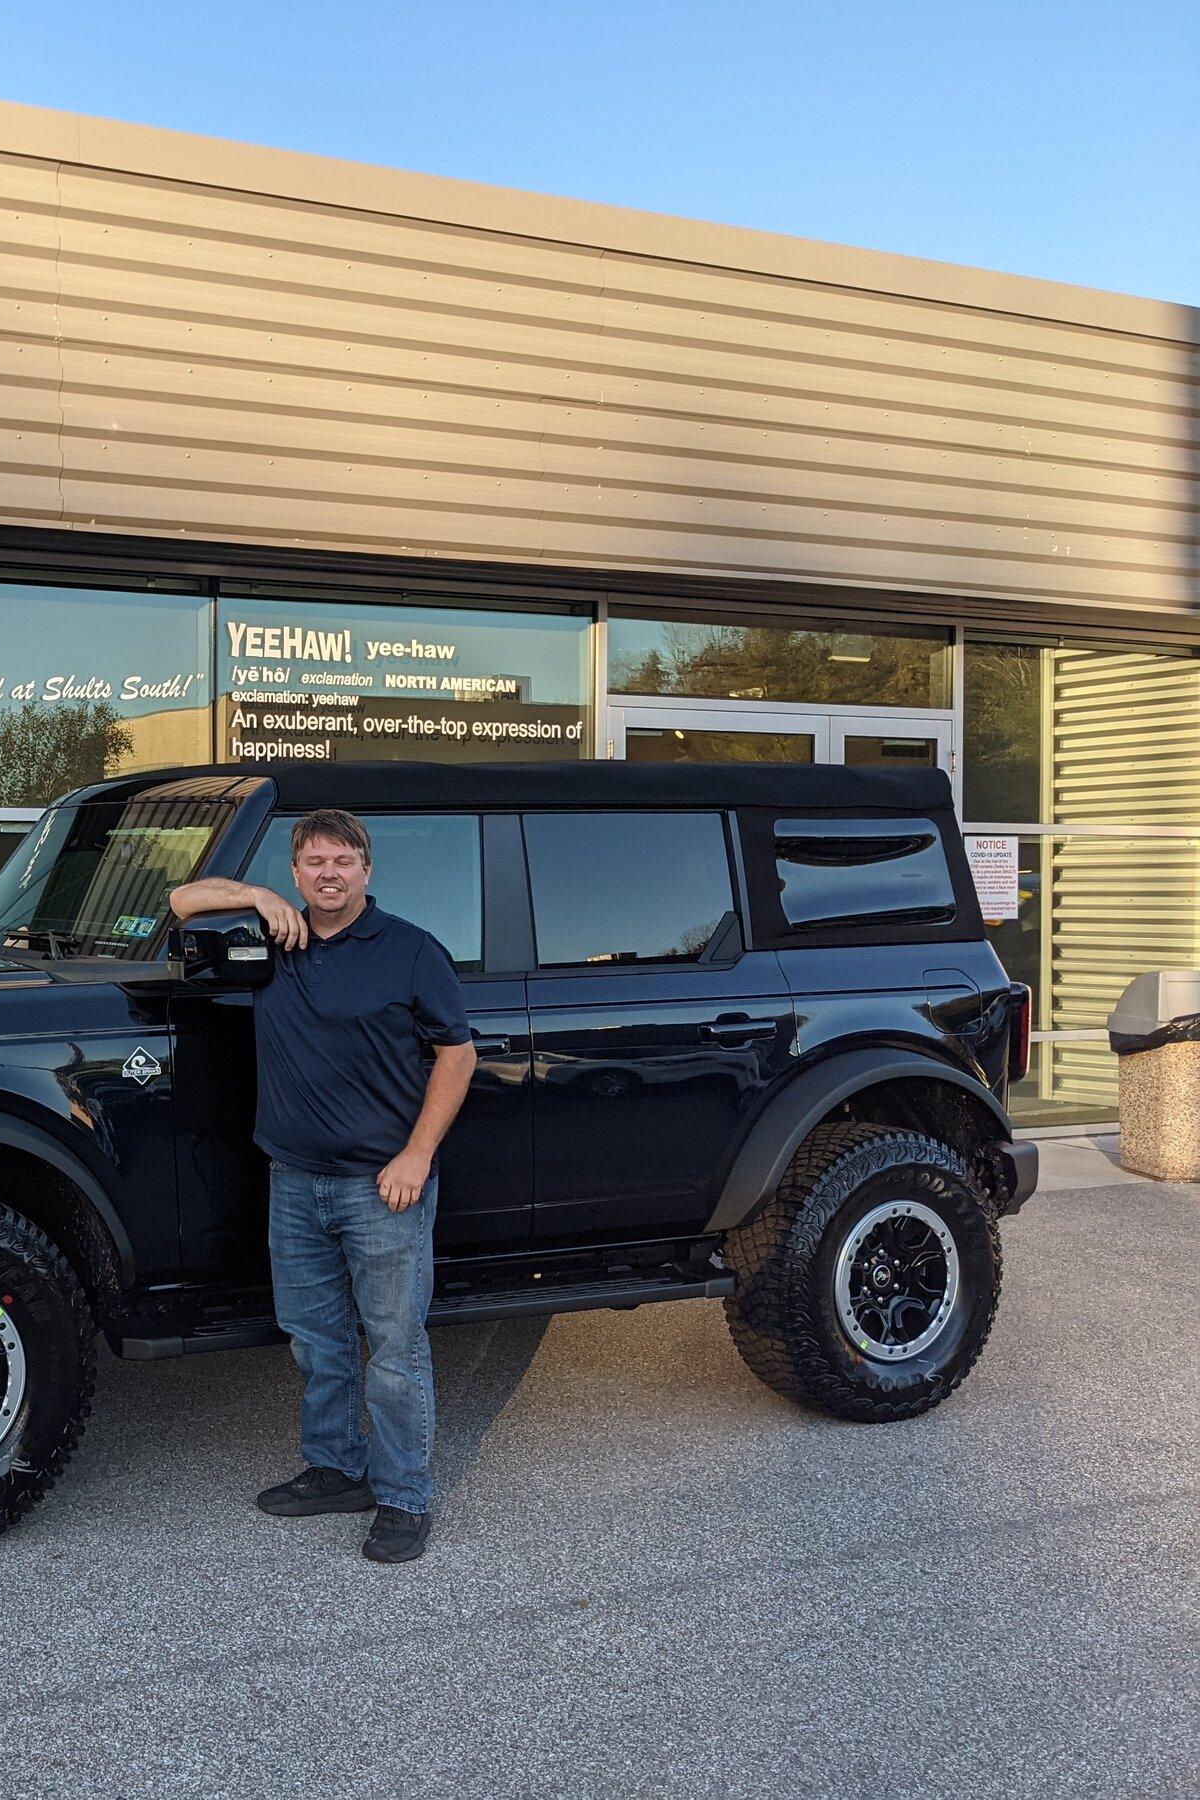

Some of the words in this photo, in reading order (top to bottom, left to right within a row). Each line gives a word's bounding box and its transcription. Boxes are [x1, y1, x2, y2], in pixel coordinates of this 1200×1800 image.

[227, 621, 352, 664] YEEHAW!
[366, 638, 456, 660] yee-haw
[11, 681, 35, 701] at
[42, 675, 112, 701] Shults
[301, 672, 373, 687] exclamation
[385, 674, 436, 690] NORTH
[441, 677, 516, 693] AMERICAN
[232, 689, 309, 705] exclamation:
[312, 693, 360, 707] yeehaw
[232, 709, 257, 729] An
[263, 711, 358, 735] exuberant,
[363, 716, 467, 740] over-the-top
[472, 721, 562, 742] expression
[566, 720, 583, 739] of
[232, 738, 331, 760] happiness!
[976, 840, 1007, 849] NOTICE
